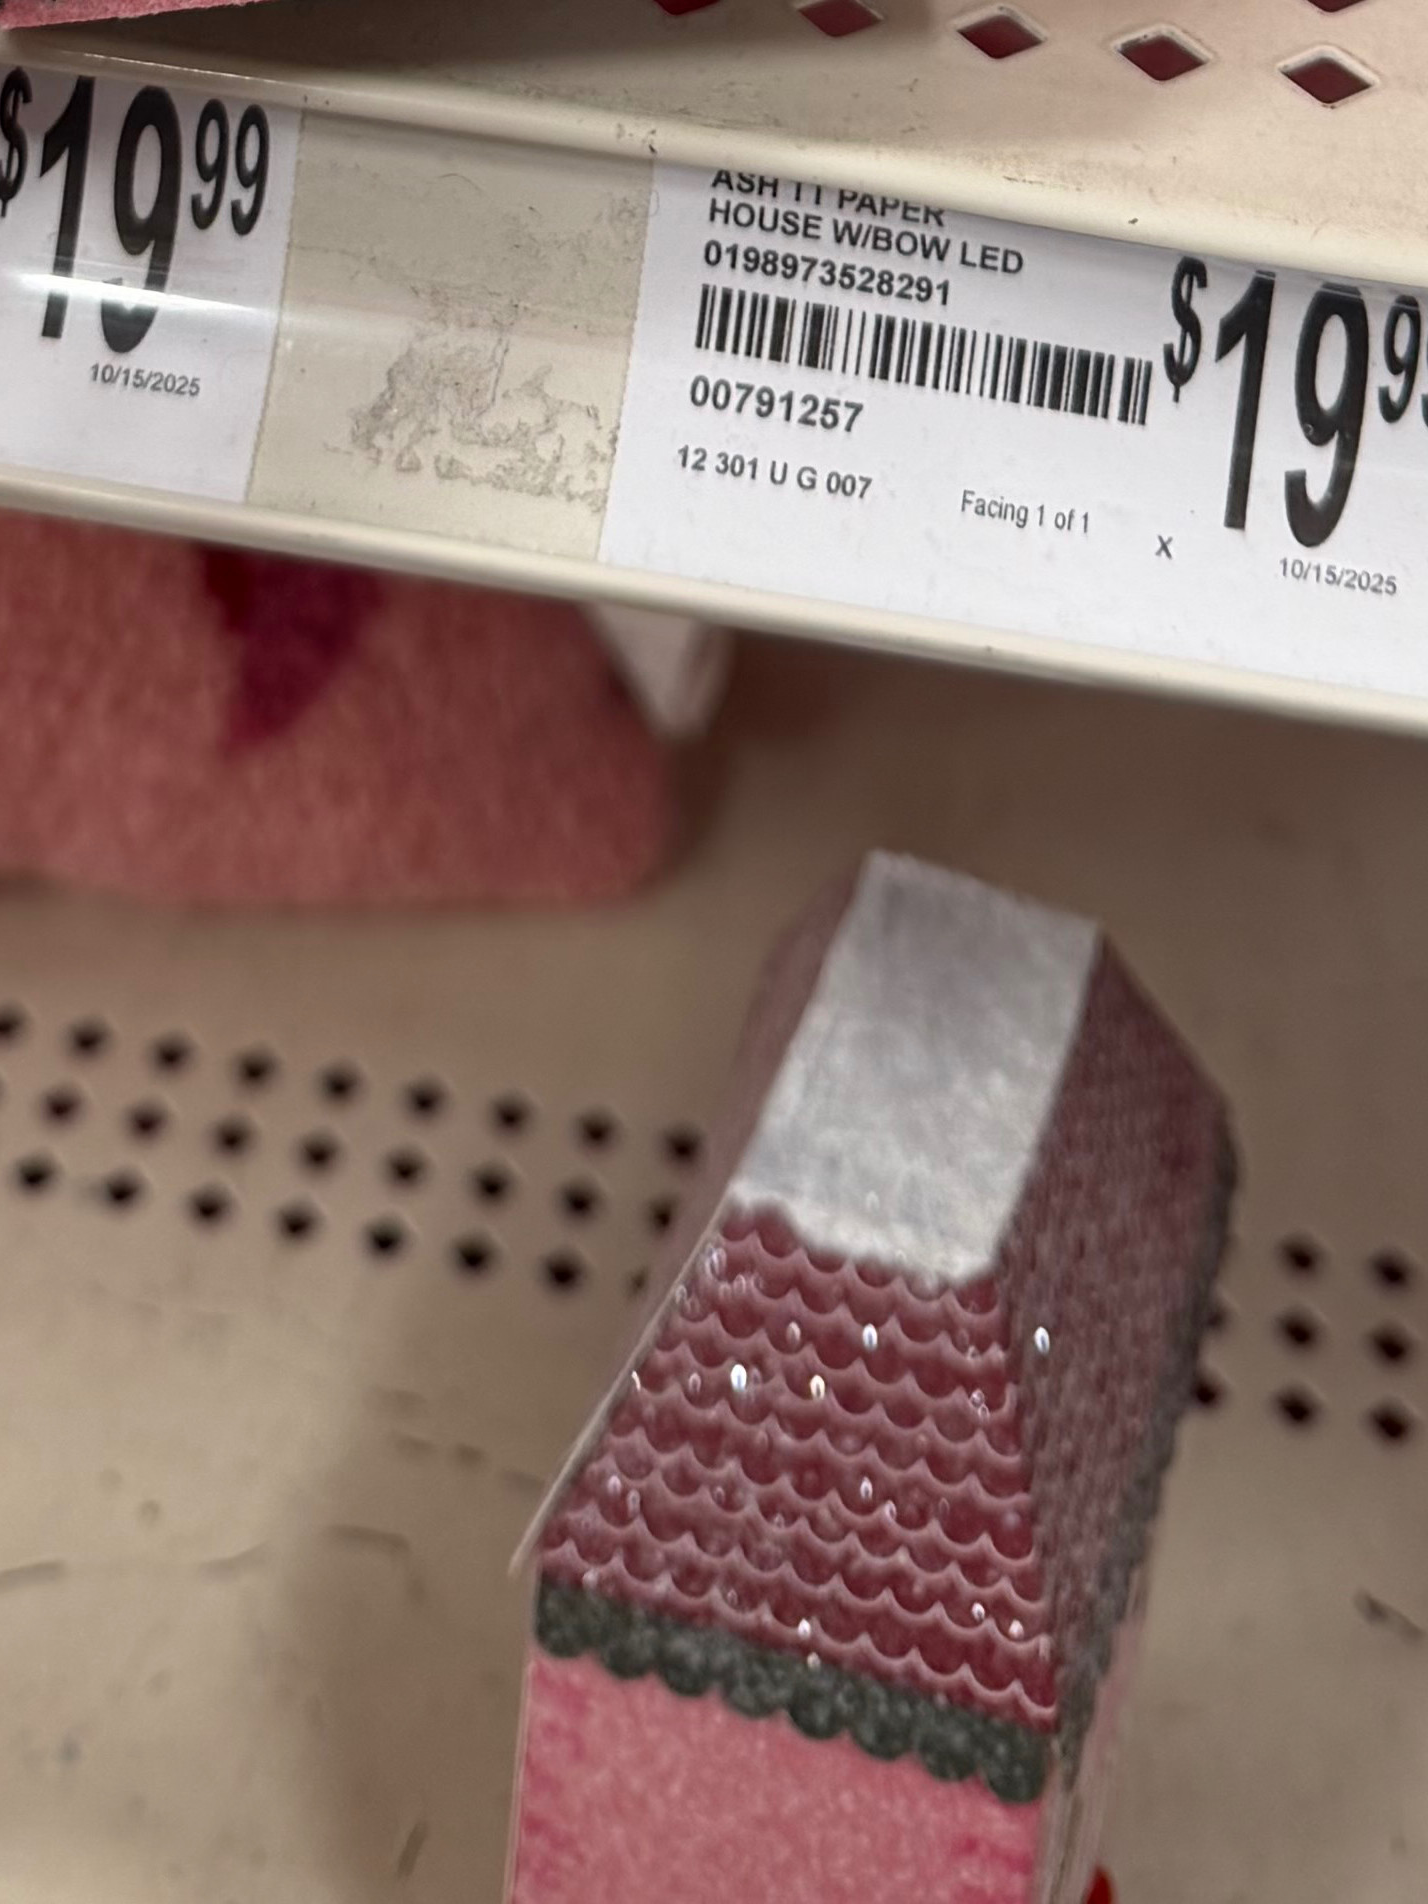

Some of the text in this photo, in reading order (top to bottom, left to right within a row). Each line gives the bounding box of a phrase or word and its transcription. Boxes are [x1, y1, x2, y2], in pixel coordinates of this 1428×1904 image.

[711, 168, 780, 198] ASH
[836, 188, 946, 228] PAPER
[709, 197, 1025, 275] HOUSE W/BOW LED
[703, 239, 951, 306] 0198973528291
[90, 363, 202, 397] 10/15/2025
[689, 374, 864, 433] 00791257
[677, 444, 873, 499] 12 301 U G 007
[961, 489, 1090, 534] Facing 1 of 1
[1279, 557, 1398, 596] 10/15/2025
